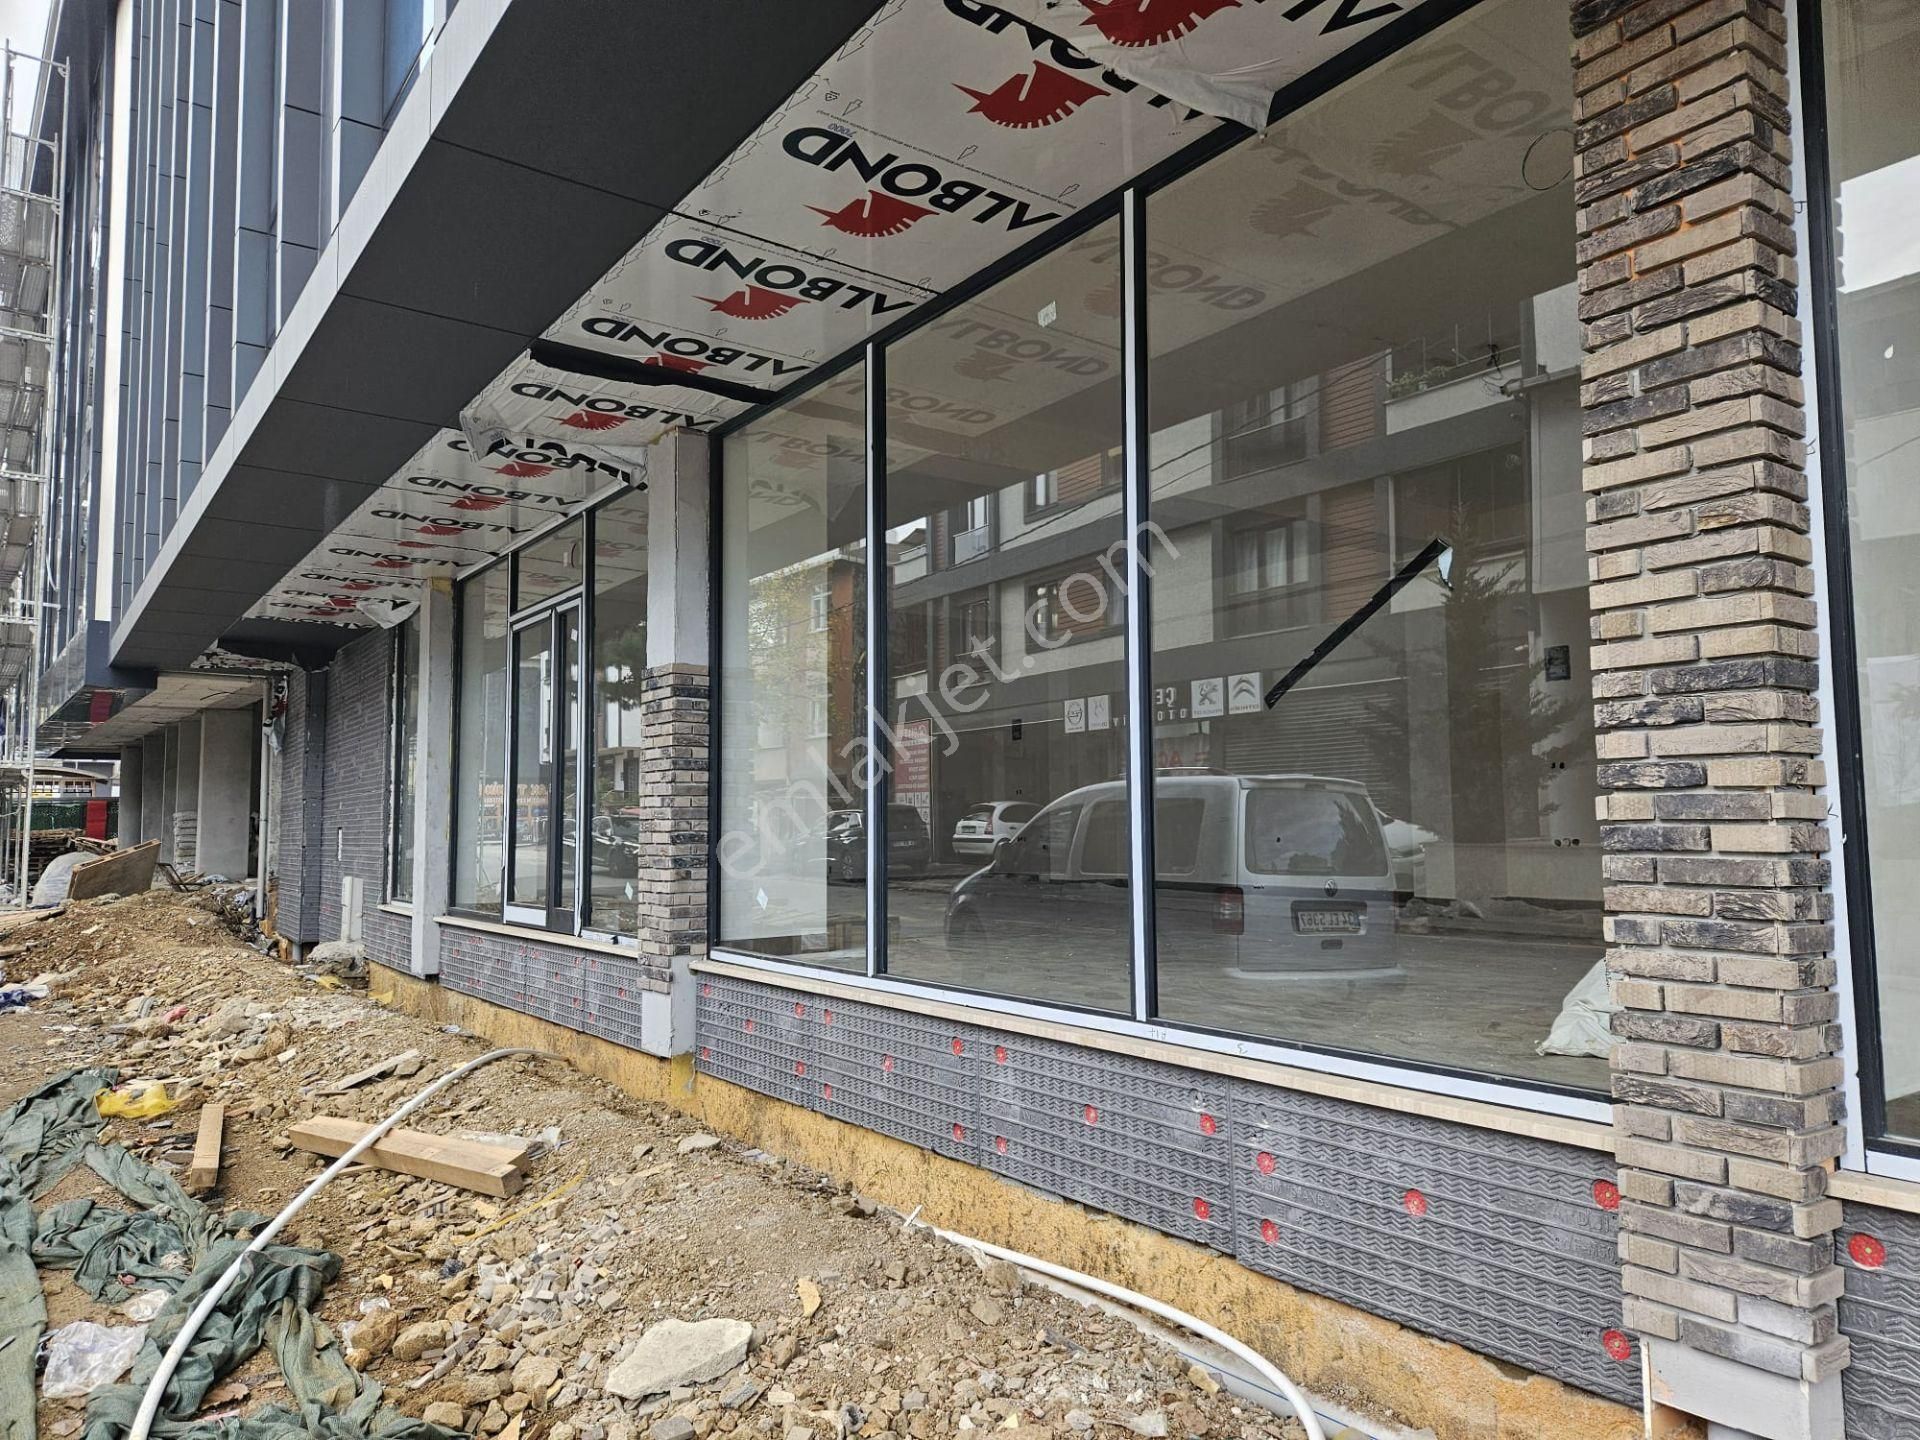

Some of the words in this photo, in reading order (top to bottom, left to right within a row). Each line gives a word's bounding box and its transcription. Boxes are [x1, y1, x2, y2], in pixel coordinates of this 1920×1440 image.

[782, 126, 1062, 232] ALBOND
[664, 238, 916, 316] ALBOND
[581, 317, 811, 376] ALBOND
[511, 383, 719, 428] ALBOND
[407, 476, 585, 506] ALBOND
[370, 510, 534, 534] ALBOND
[328, 548, 476, 568] ALBOND
